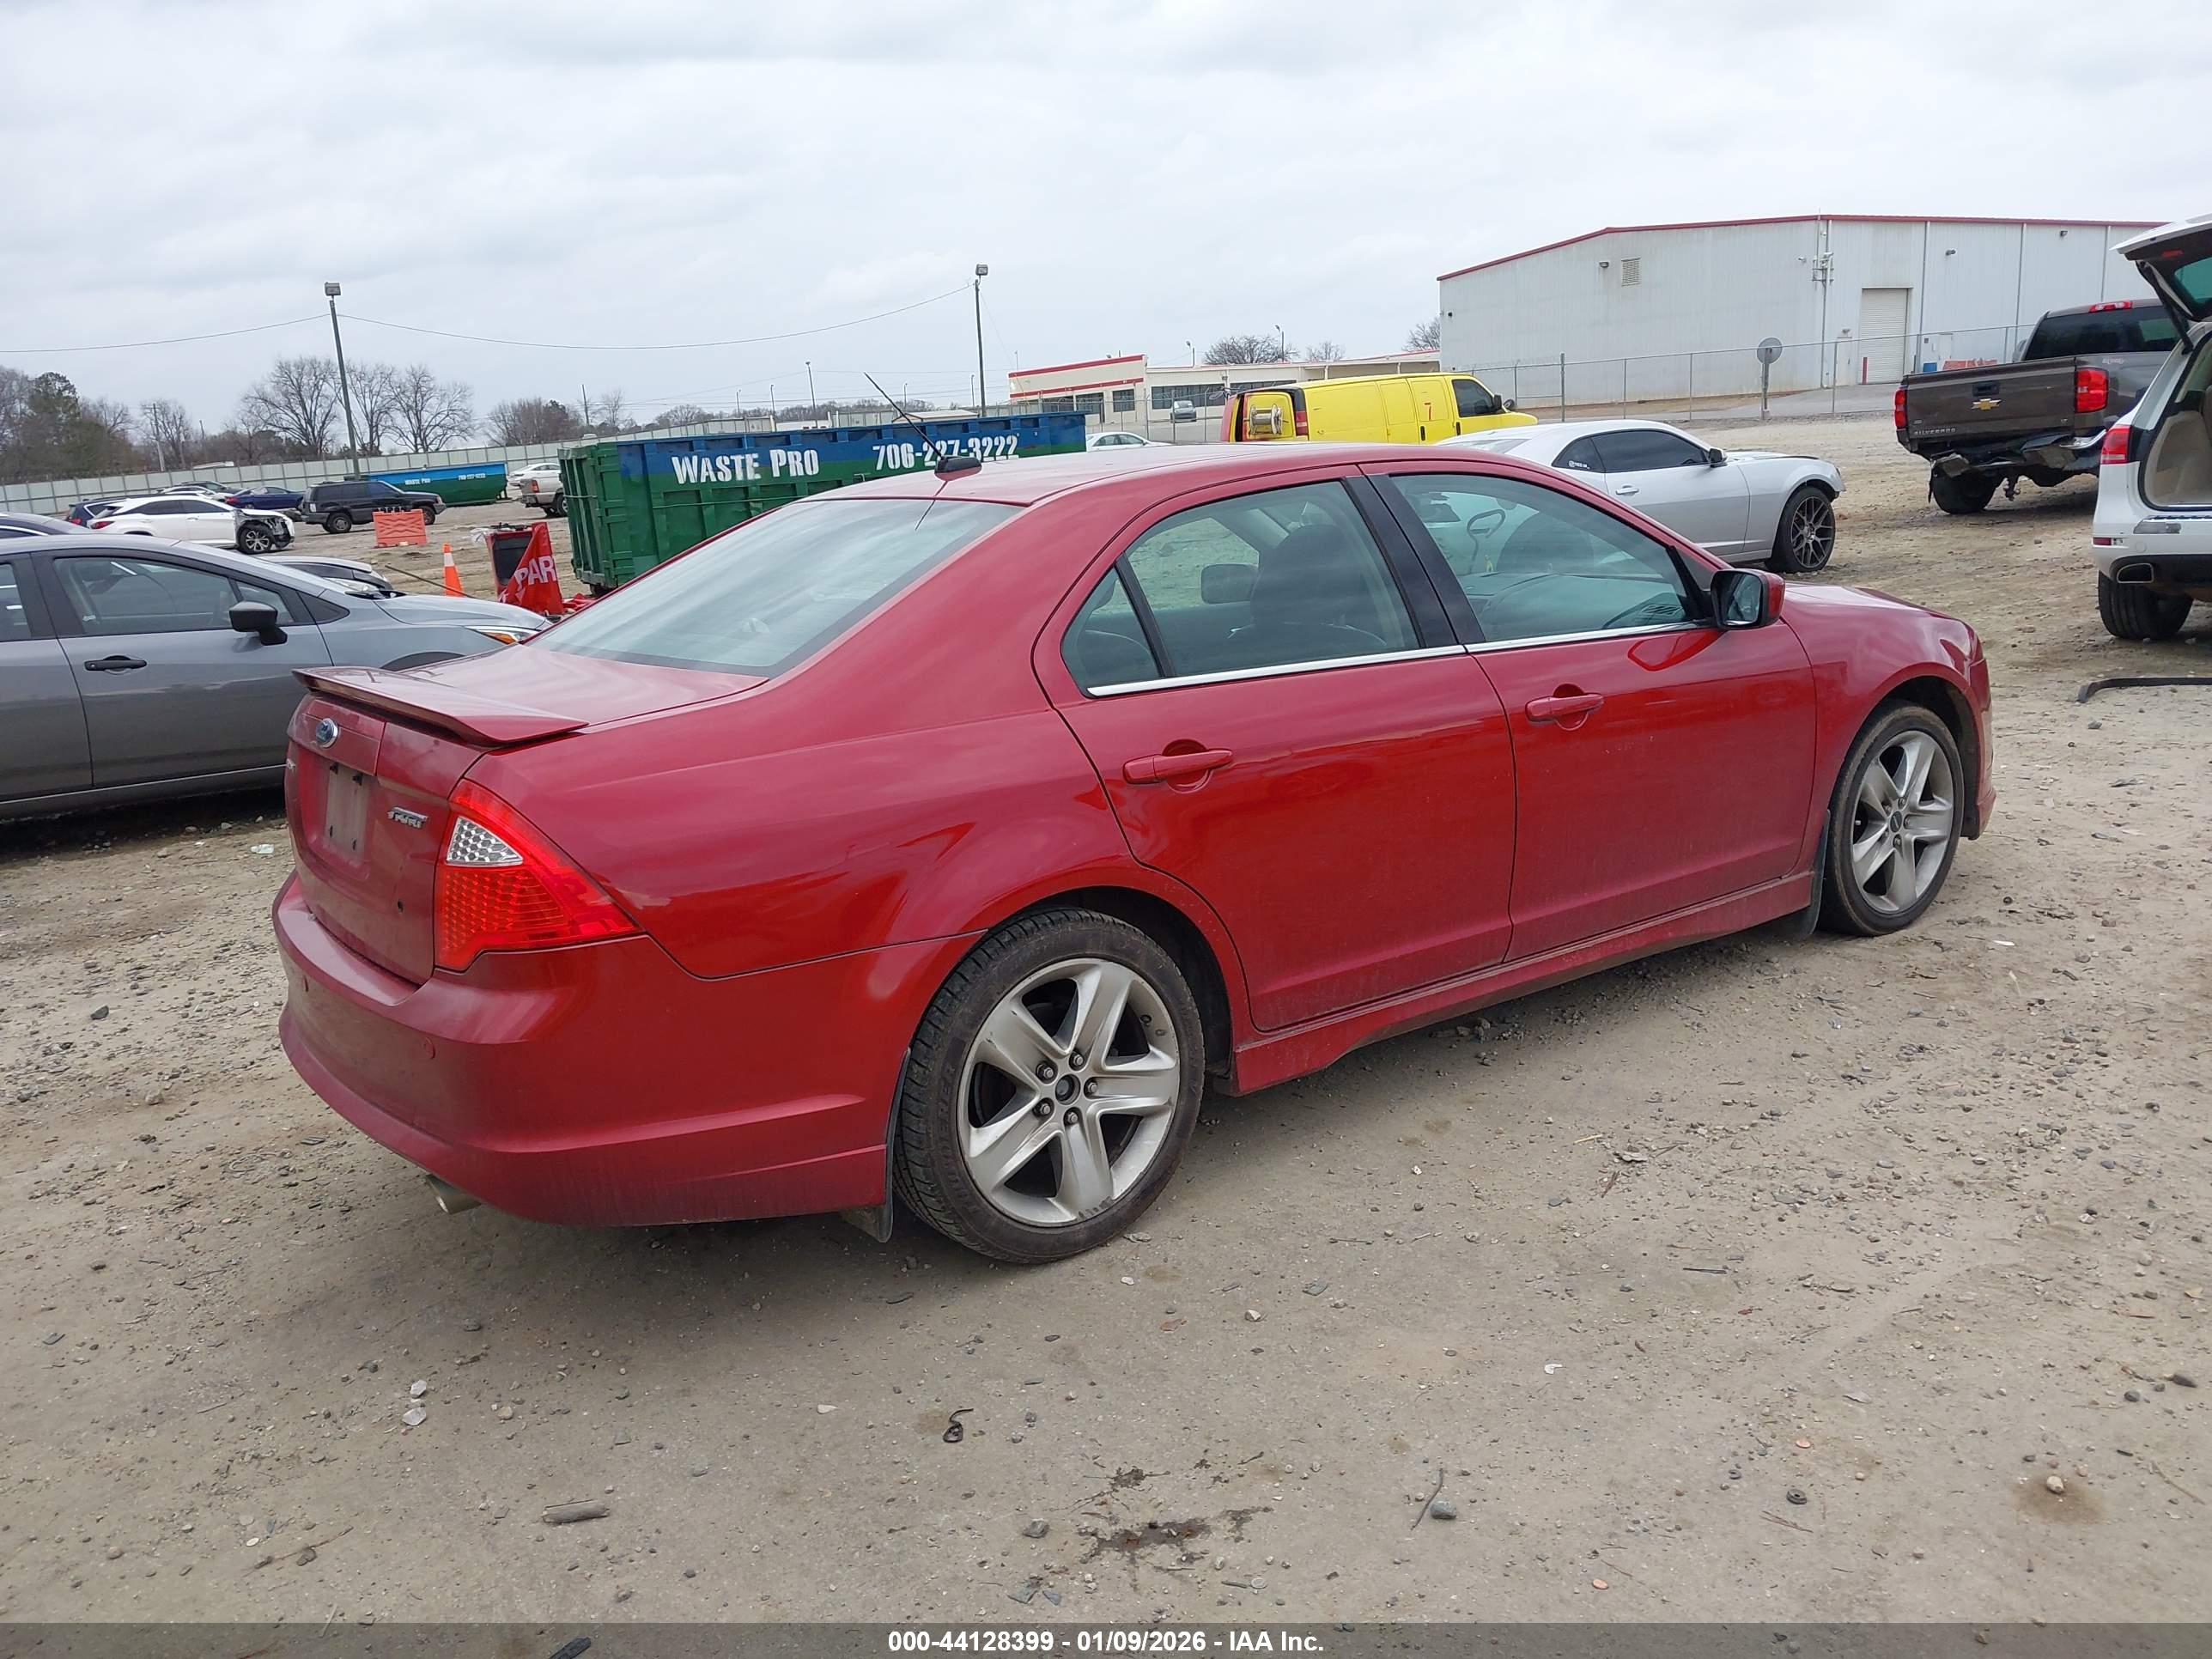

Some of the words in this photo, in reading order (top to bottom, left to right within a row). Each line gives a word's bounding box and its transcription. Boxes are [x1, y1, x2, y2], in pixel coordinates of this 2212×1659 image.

[1424, 402, 1431, 421] 7
[672, 453, 762, 484] WASTE
[769, 449, 819, 477] PRO
